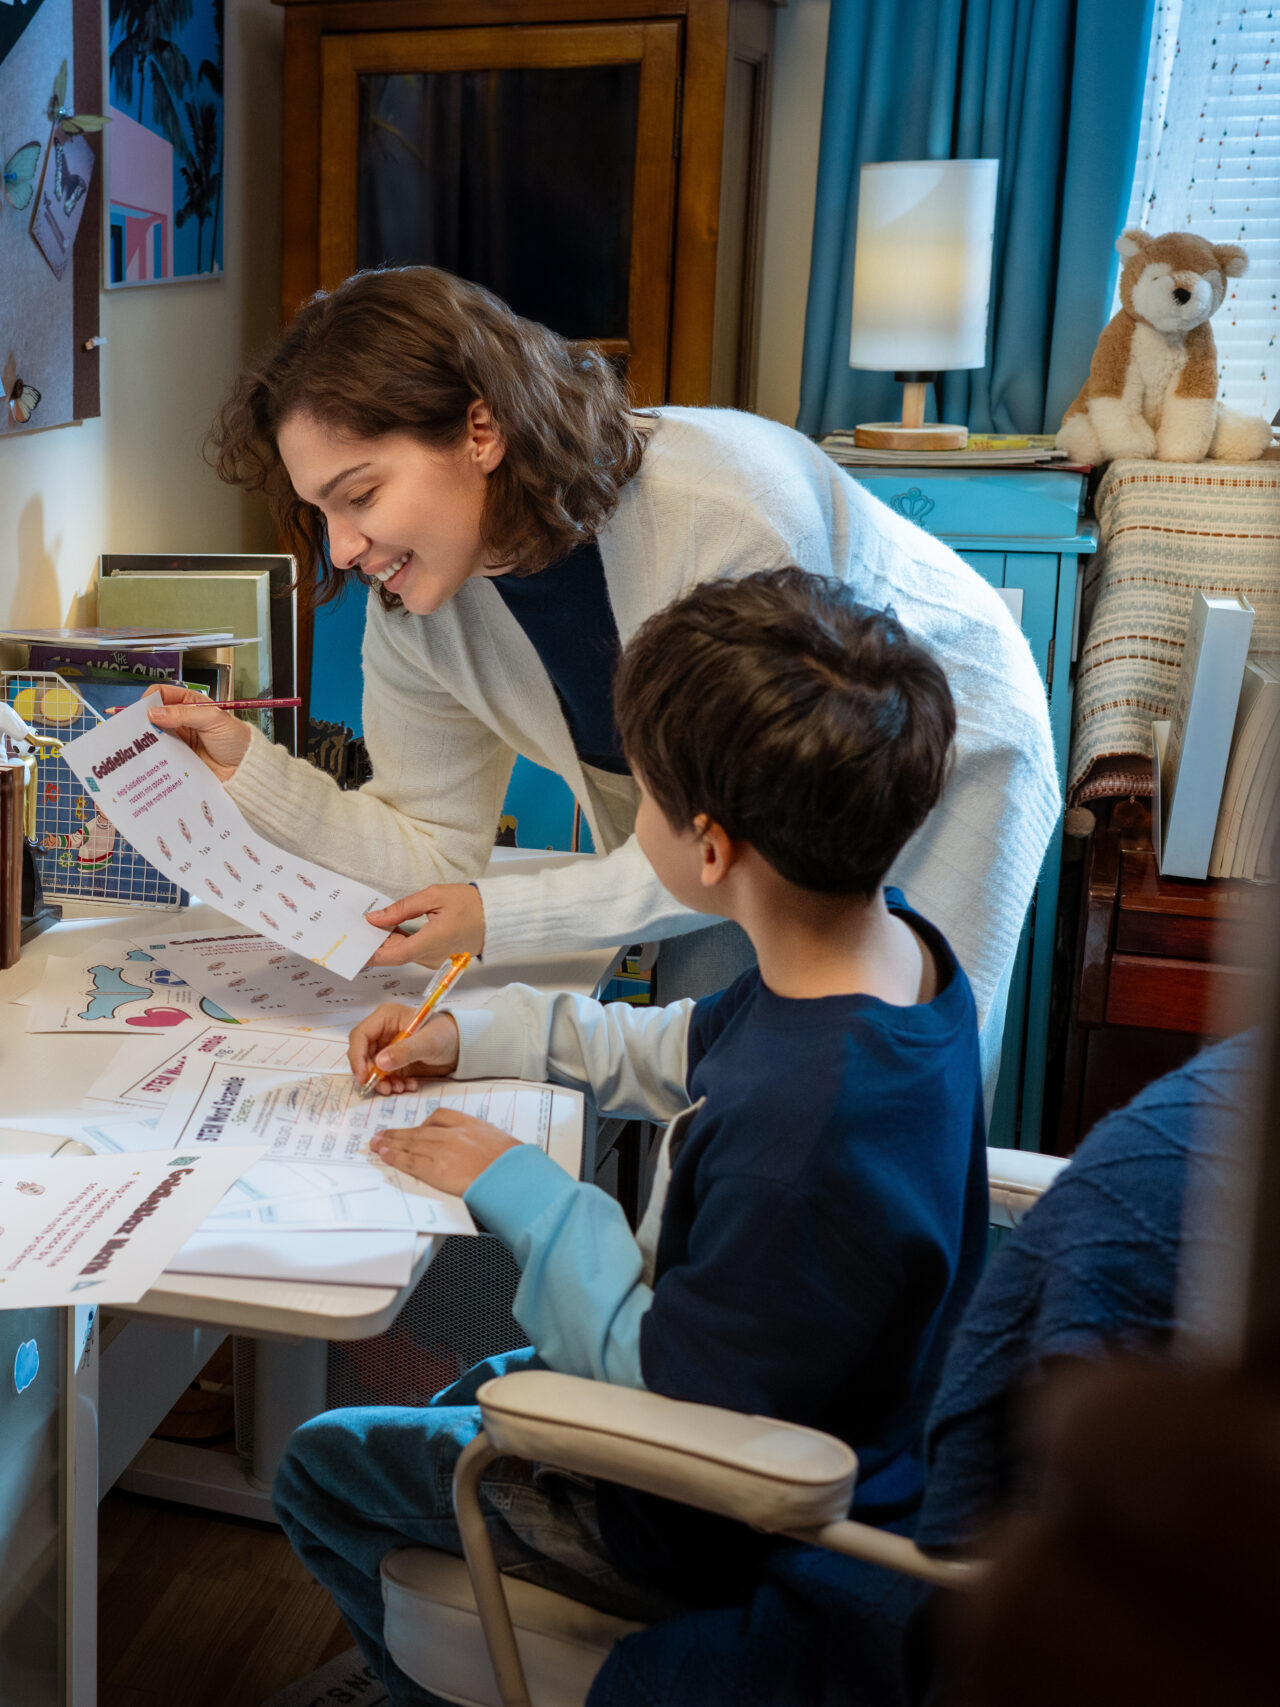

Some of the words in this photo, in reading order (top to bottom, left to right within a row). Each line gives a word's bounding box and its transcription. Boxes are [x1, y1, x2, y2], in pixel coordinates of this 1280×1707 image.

[132, 731, 160, 755] Math
[141, 1076, 168, 1093] STEM
[205, 1101, 233, 1124] Word
[195, 1122, 225, 1142] STEM
